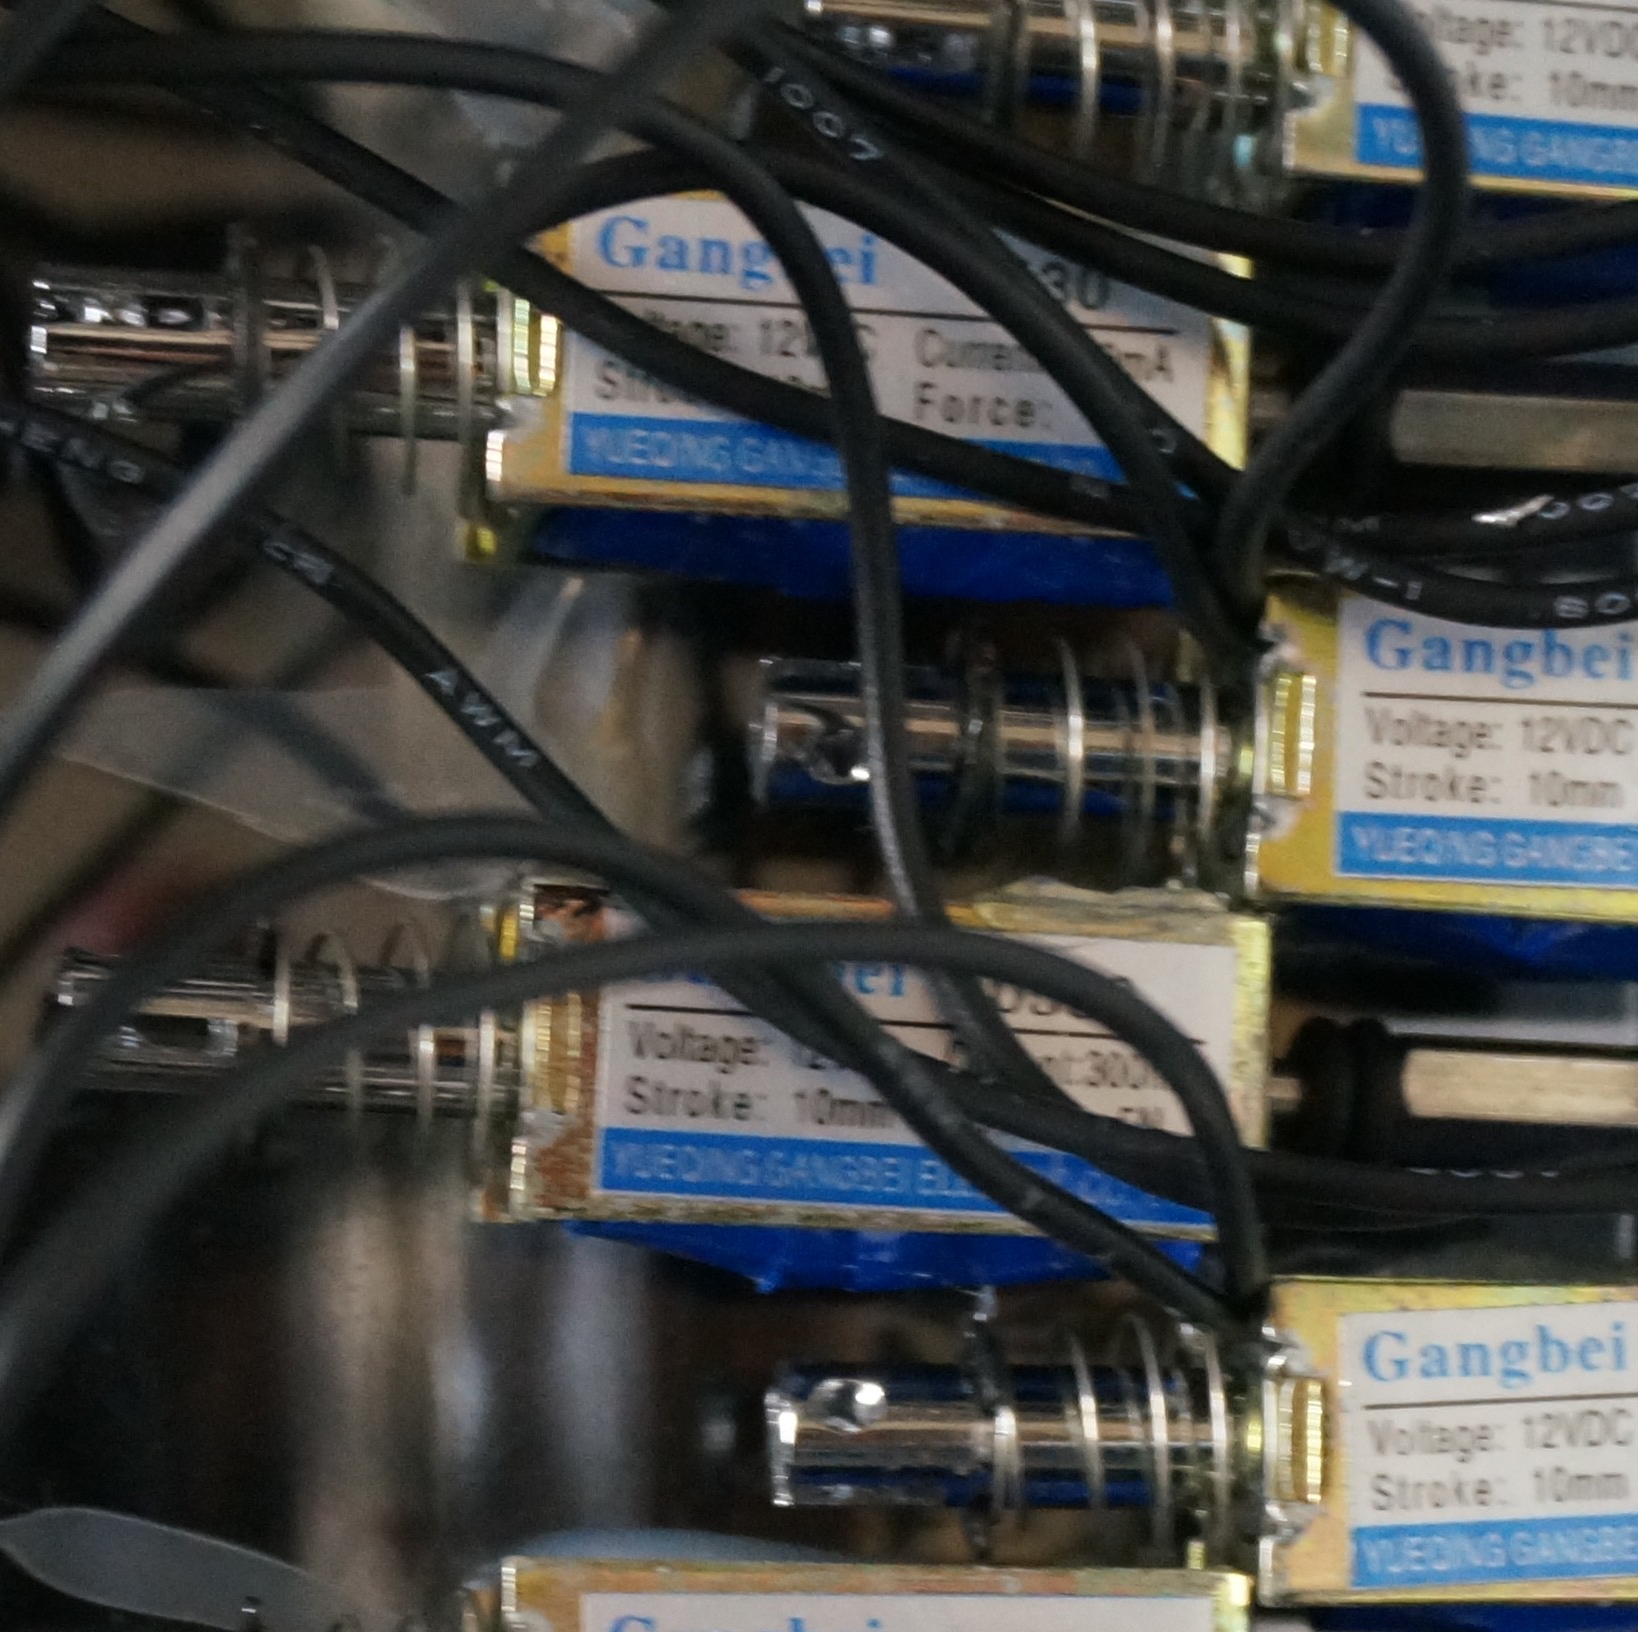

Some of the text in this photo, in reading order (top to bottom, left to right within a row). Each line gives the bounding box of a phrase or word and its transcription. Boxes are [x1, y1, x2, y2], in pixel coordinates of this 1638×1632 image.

[598, 214, 879, 291] Gangei
[1364, 616, 1634, 689] Gangbei
[423, 667, 541, 768] AWM
[1366, 707, 1634, 757] Voltage: 12VDC
[1365, 760, 1626, 810] Stroke: 10mm
[629, 1018, 771, 1075] Voltage:
[625, 1073, 769, 1121] Stroke:
[1364, 1321, 1628, 1388] Gangbei
[1367, 1408, 1634, 1463] Voltage: 12VDC
[1370, 1467, 1629, 1513] Stroke: 10mm
